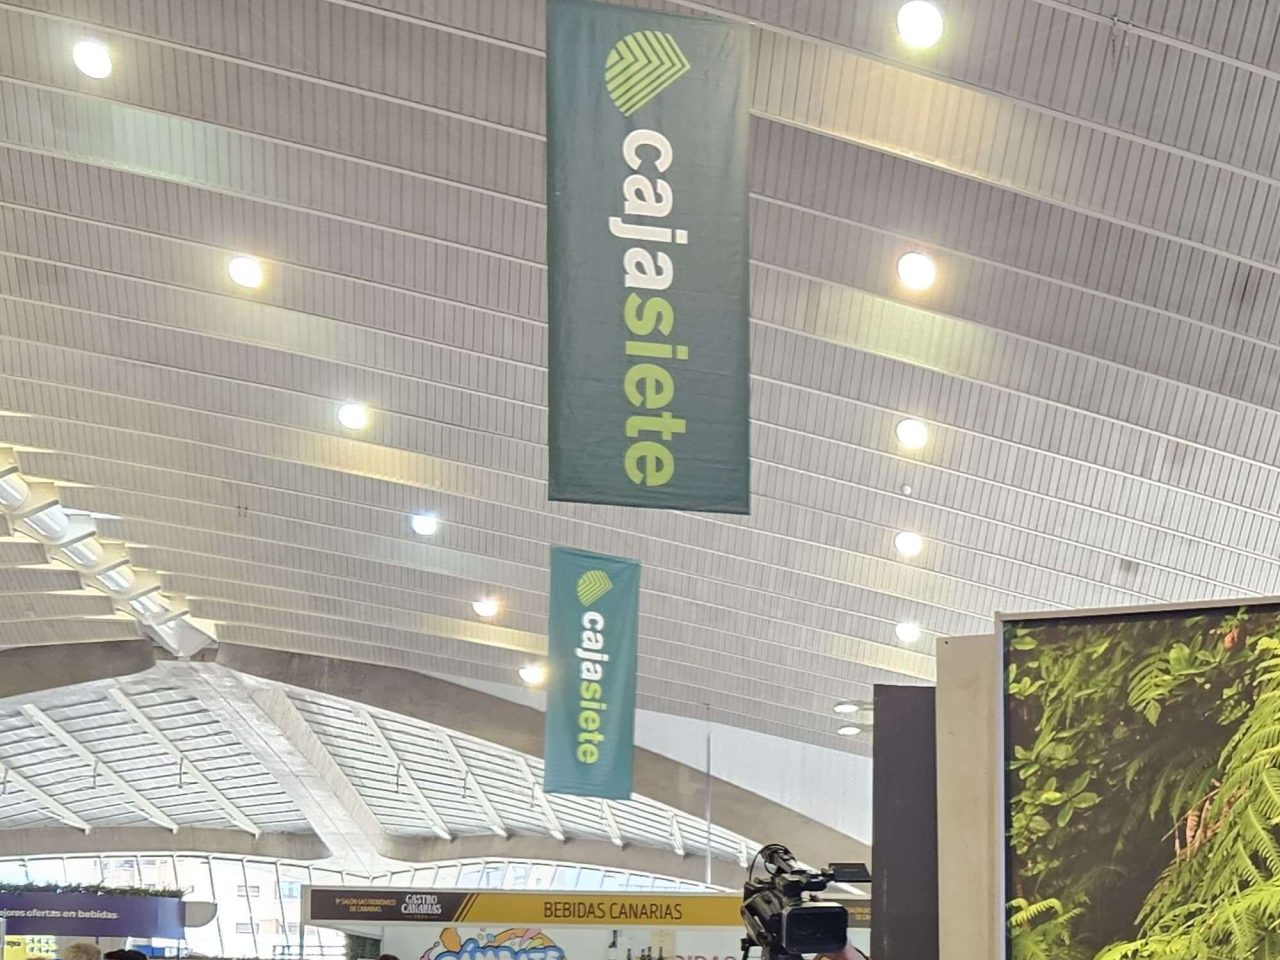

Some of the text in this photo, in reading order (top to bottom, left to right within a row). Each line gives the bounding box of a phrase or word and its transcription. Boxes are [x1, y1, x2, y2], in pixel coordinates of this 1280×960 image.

[609, 129, 688, 487] cajasiete
[575, 611, 610, 765] cajasiete
[405, 895, 439, 905] GASTRO
[0, 908, 26, 918] ejores
[26, 908, 62, 918] ofertas
[63, 910, 77, 918] en
[401, 904, 443, 914] CANARIAS
[543, 902, 683, 920] BEBIDAS CANARIAS
